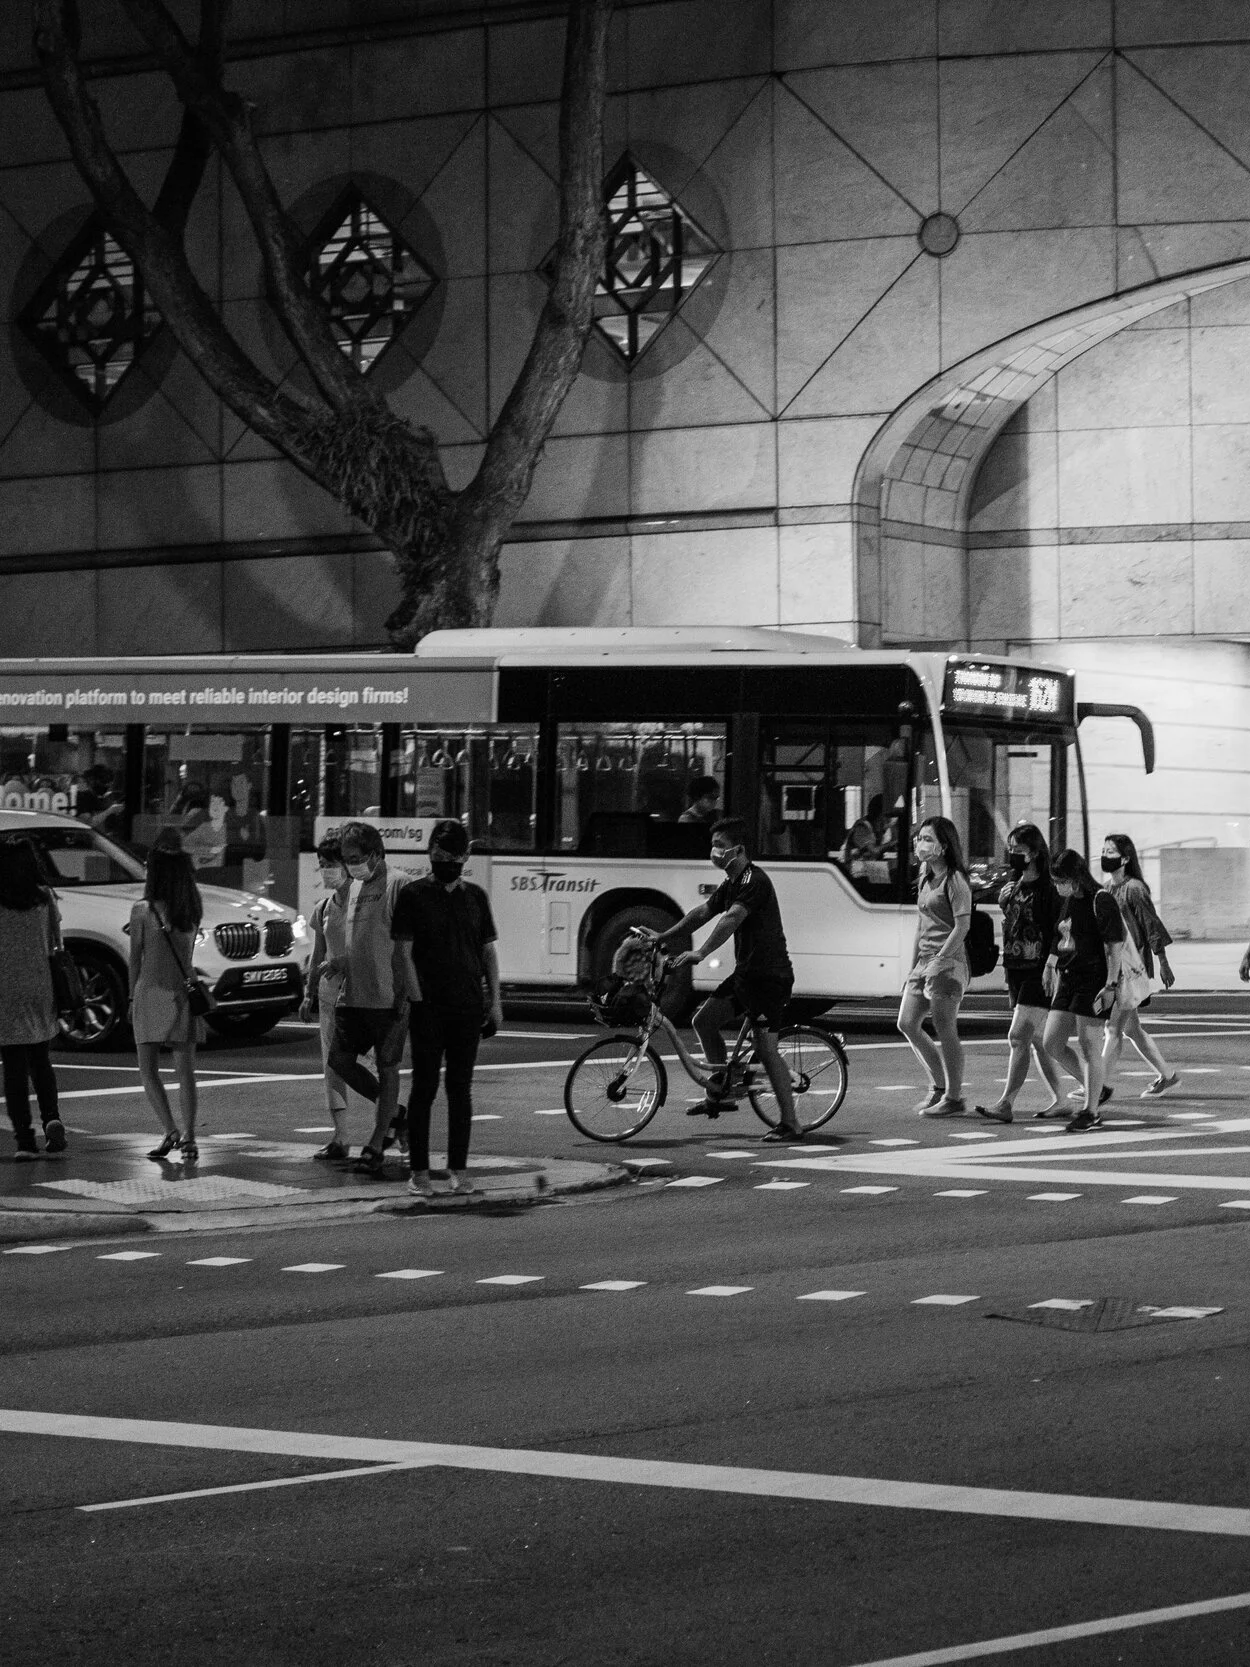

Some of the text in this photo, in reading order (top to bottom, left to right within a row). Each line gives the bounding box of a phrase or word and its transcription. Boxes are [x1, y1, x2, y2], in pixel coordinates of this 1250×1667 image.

[65, 688, 128, 709] platform
[130, 689, 146, 705] to
[148, 689, 187, 705] meet
[189, 687, 245, 705] reliable
[248, 687, 305, 705] interior
[306, 686, 359, 708] design
[362, 686, 409, 705] firms!
[510, 872, 601, 893] SBS Transit
